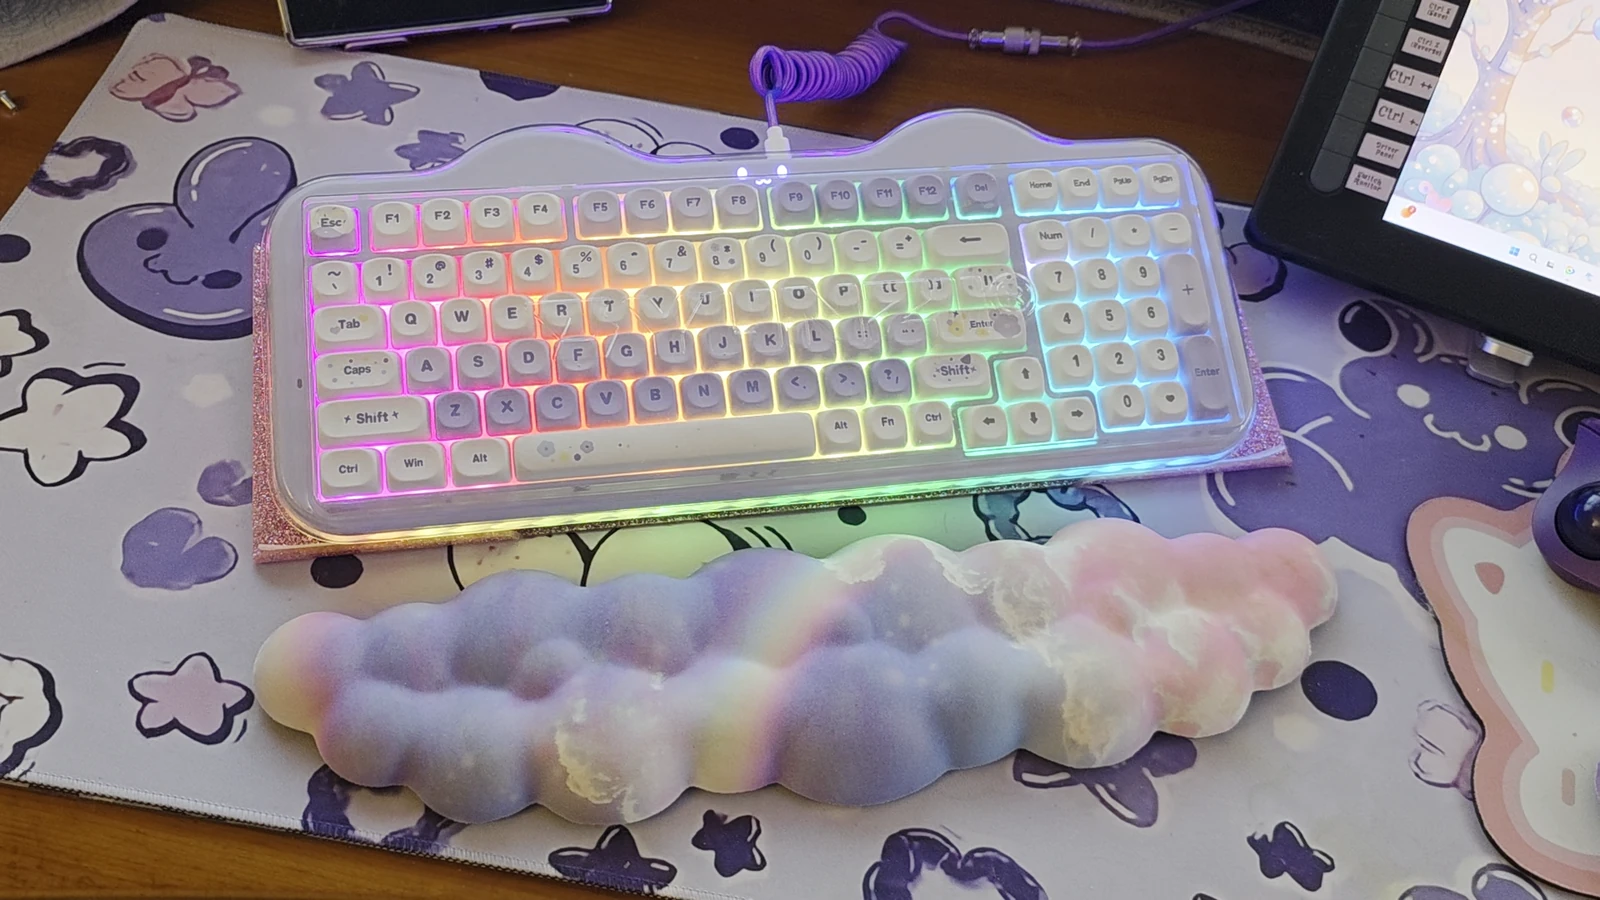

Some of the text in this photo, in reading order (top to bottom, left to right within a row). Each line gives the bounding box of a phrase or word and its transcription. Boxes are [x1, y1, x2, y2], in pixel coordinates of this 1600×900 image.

[1429, 3, 1443, 12] Ctrl
[1418, 37, 1432, 46] Ctrl
[1389, 69, 1415, 86] Ctrl
[1378, 105, 1404, 123] Ctrl
[1376, 141, 1399, 154] Driver
[1375, 149, 1395, 160] Panel
[1073, 179, 1091, 187] End
[1357, 171, 1382, 186] Switch
[918, 186, 938, 196] F12
[974, 184, 988, 192] Del
[1029, 181, 1052, 189] Home
[789, 192, 803, 202] F9
[830, 190, 850, 200] F10
[876, 188, 893, 198] F11
[640, 200, 655, 209] F6
[686, 198, 700, 207] F7
[731, 196, 746, 205] F8
[484, 208, 500, 217] F3
[533, 204, 548, 214] F4
[593, 203, 608, 212] F5
[385, 213, 400, 223] F1
[435, 211, 451, 220] F2
[320, 217, 342, 227] Esc
[1039, 231, 1063, 240] Num
[1054, 271, 1062, 283] 7
[1098, 268, 1106, 281] 8
[1139, 266, 1147, 278] 9
[838, 286, 849, 296] P
[604, 300, 614, 312] T
[652, 297, 663, 308] Y
[454, 310, 469, 322] W
[507, 307, 517, 320] E
[556, 304, 567, 316] R
[1105, 309, 1114, 321] 5
[1147, 307, 1155, 319] 6
[338, 318, 361, 330] Tab
[404, 312, 417, 325] Q
[969, 319, 993, 329] Enter
[1063, 312, 1071, 325] 4
[718, 336, 727, 349] J
[765, 334, 776, 346] K
[812, 331, 821, 342] L
[620, 345, 632, 357] G
[669, 340, 680, 353] H
[473, 355, 484, 367] S
[523, 351, 534, 364] D
[573, 349, 583, 361] F
[1072, 355, 1080, 367] 1
[1115, 352, 1123, 365] 2
[1157, 349, 1165, 361] 3
[343, 365, 372, 376] Caps
[420, 359, 433, 372] A
[940, 364, 970, 377] Shift
[1195, 367, 1220, 377] Enter
[698, 384, 710, 397] N
[746, 381, 759, 393] M
[600, 392, 612, 405] V
[650, 388, 661, 400] B
[501, 400, 514, 413] X
[552, 397, 563, 409] C
[1123, 394, 1132, 408] 0
[450, 404, 461, 416] Z
[356, 411, 388, 424] Shift
[881, 417, 894, 426] Fn
[925, 413, 942, 422] Ctrl
[834, 421, 848, 430] Alt
[404, 458, 424, 468] Win
[472, 453, 488, 463] Alt
[338, 464, 359, 474] Ctrl
